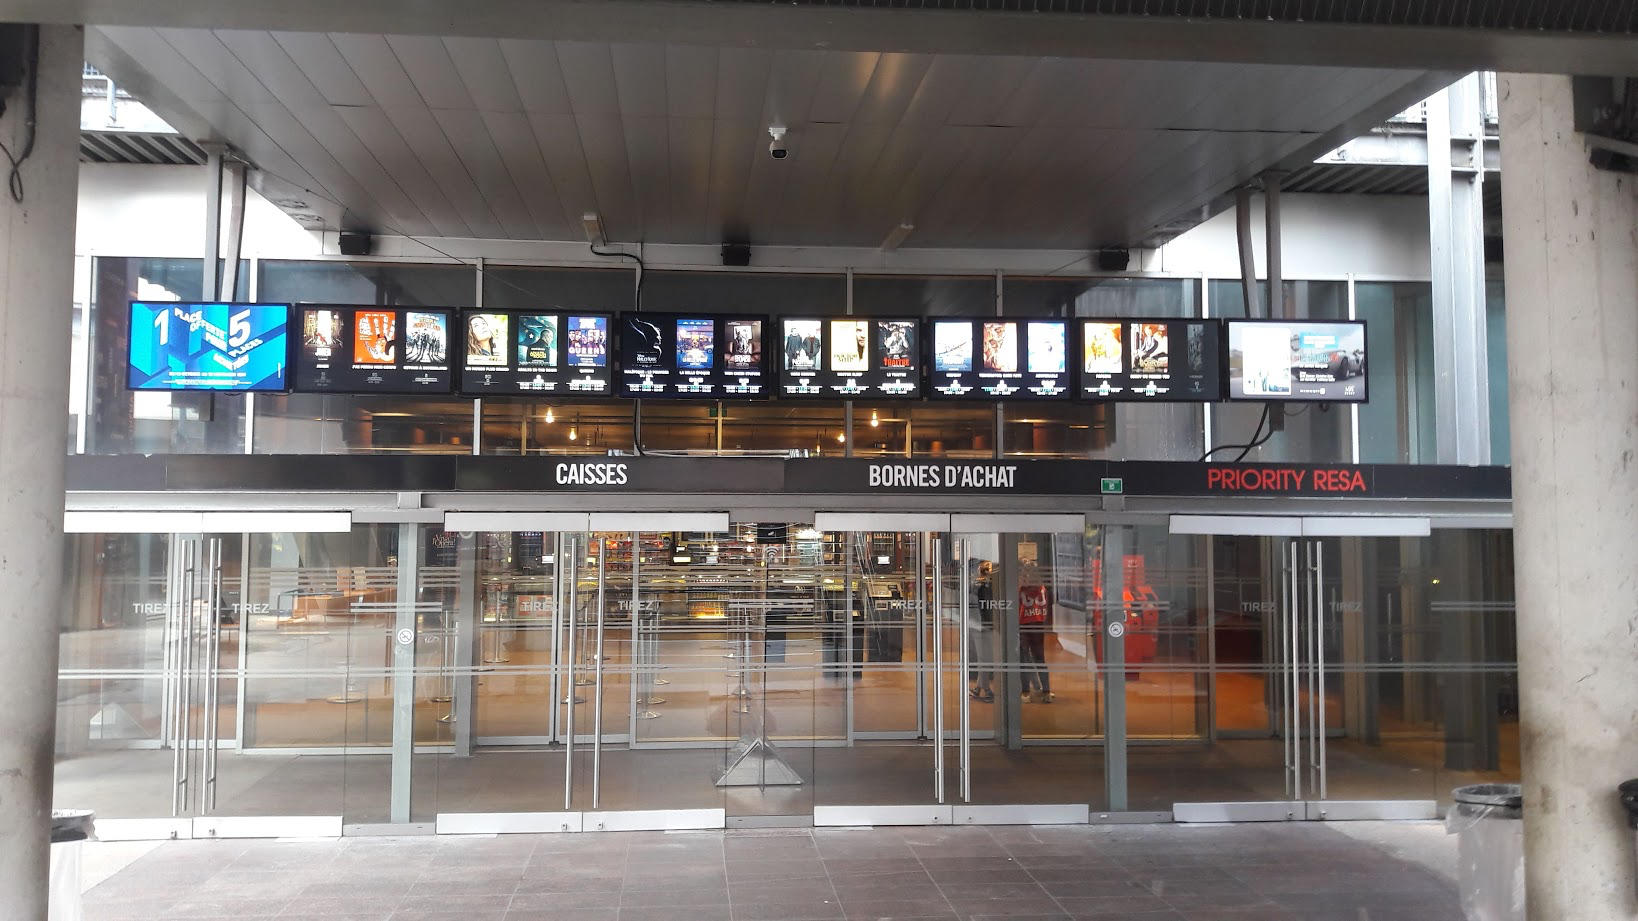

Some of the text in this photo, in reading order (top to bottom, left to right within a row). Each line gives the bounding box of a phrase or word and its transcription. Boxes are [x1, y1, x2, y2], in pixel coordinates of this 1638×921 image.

[154, 308, 169, 346] 1
[228, 308, 251, 348] 5
[555, 463, 628, 486] CAISSES
[869, 465, 1017, 488] BORNES D'ACHAT
[1207, 469, 1367, 491] PRIORITY RESA
[231, 603, 269, 614] TIREZ
[887, 600, 924, 610] TIREZ
[979, 600, 1014, 610] TIREZ
[1024, 608, 1047, 617] AHEAD
[1241, 602, 1277, 612] TIREZ
